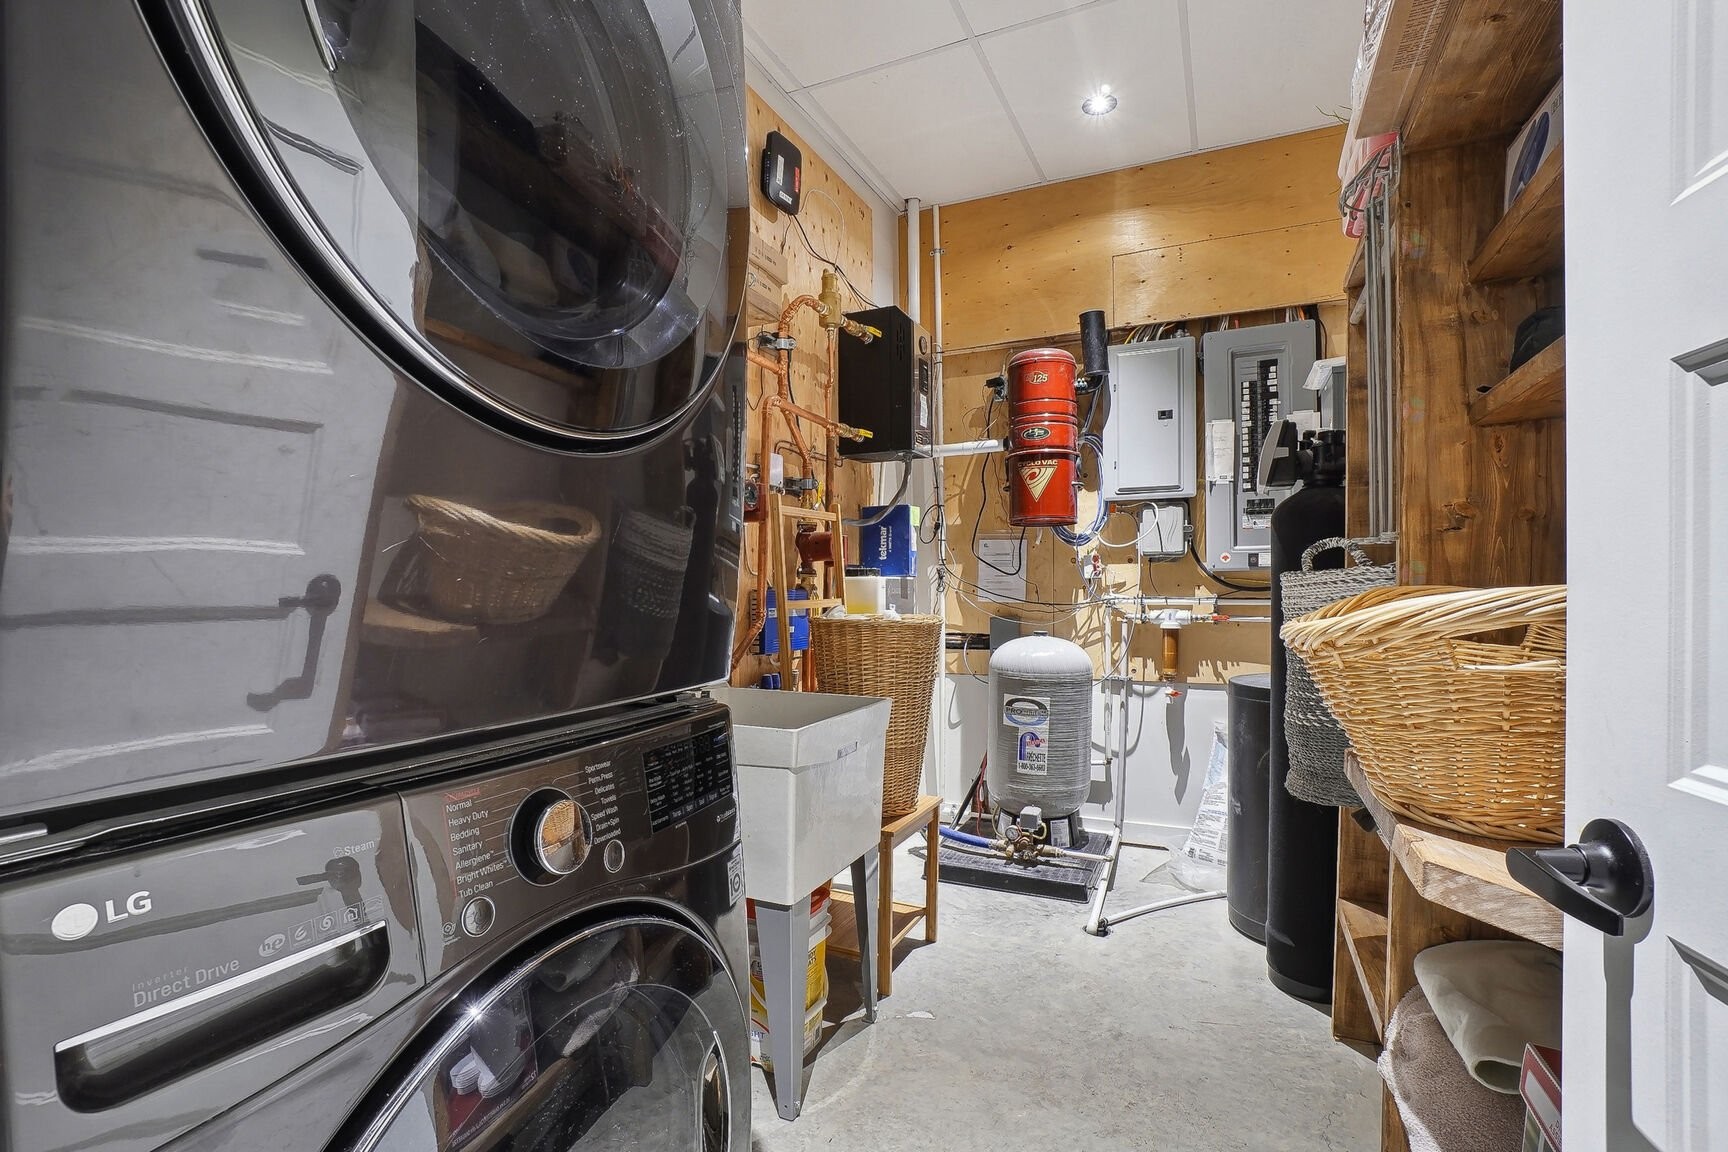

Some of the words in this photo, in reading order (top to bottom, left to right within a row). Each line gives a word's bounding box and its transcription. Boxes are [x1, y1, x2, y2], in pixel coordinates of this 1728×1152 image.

[585, 760, 611, 774] Sportswear
[594, 783, 615, 795] Delicates
[446, 800, 472, 813] Normal
[601, 794, 617, 805] Towels
[448, 815, 471, 827] Heavy
[472, 810, 489, 820] Duty
[591, 810, 605, 821] Speed
[606, 805, 618, 815] Wash
[450, 827, 480, 842] Bedding
[593, 828, 622, 845] Downloaded
[345, 840, 375, 856] Steam
[452, 841, 484, 856] Sanitary
[456, 870, 479, 885] Bright
[458, 888, 474, 899] Tub
[474, 880, 494, 893] Clean
[105, 890, 152, 924] LG
[132, 966, 190, 993] Inverter
[134, 975, 191, 1009] Direct
[195, 959, 241, 986] Drive
